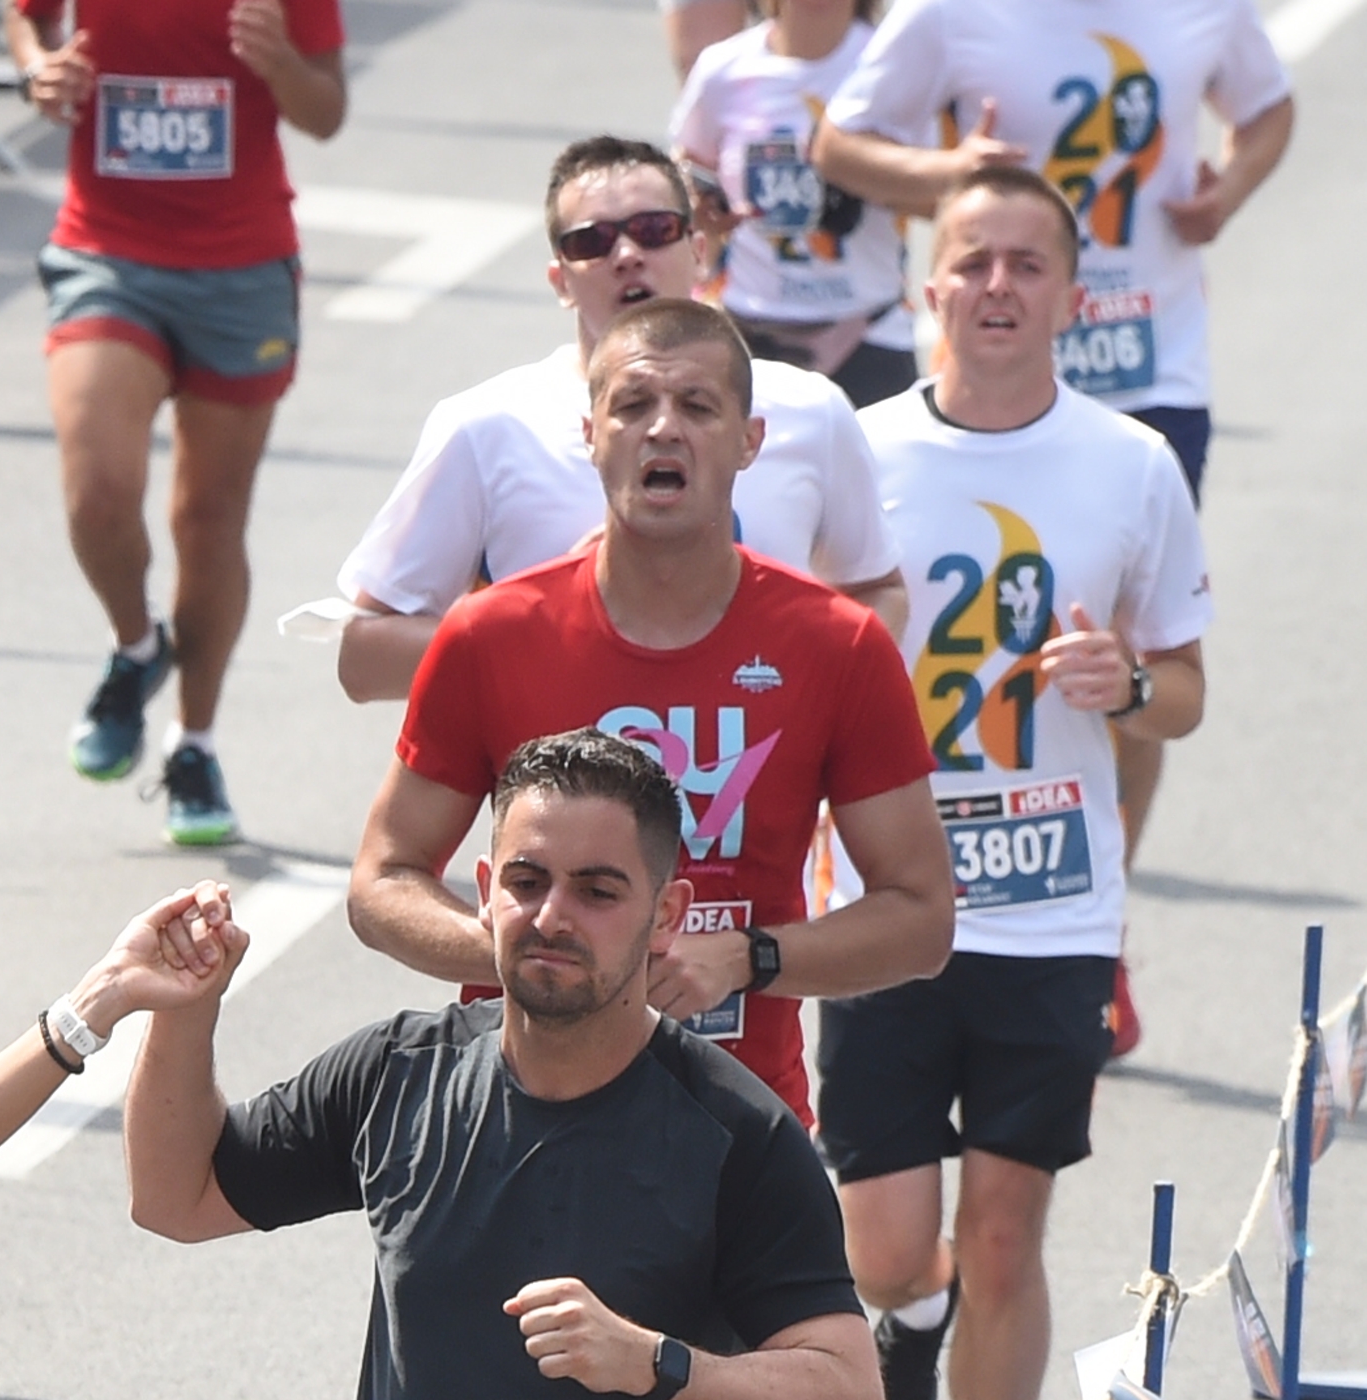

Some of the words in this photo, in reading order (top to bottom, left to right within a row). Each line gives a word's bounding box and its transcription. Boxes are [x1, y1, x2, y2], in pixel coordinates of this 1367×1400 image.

[119, 109, 211, 153] 5805
[927, 553, 1055, 655] 20
[929, 670, 1035, 771] 21
[954, 820, 1067, 883] 3807
